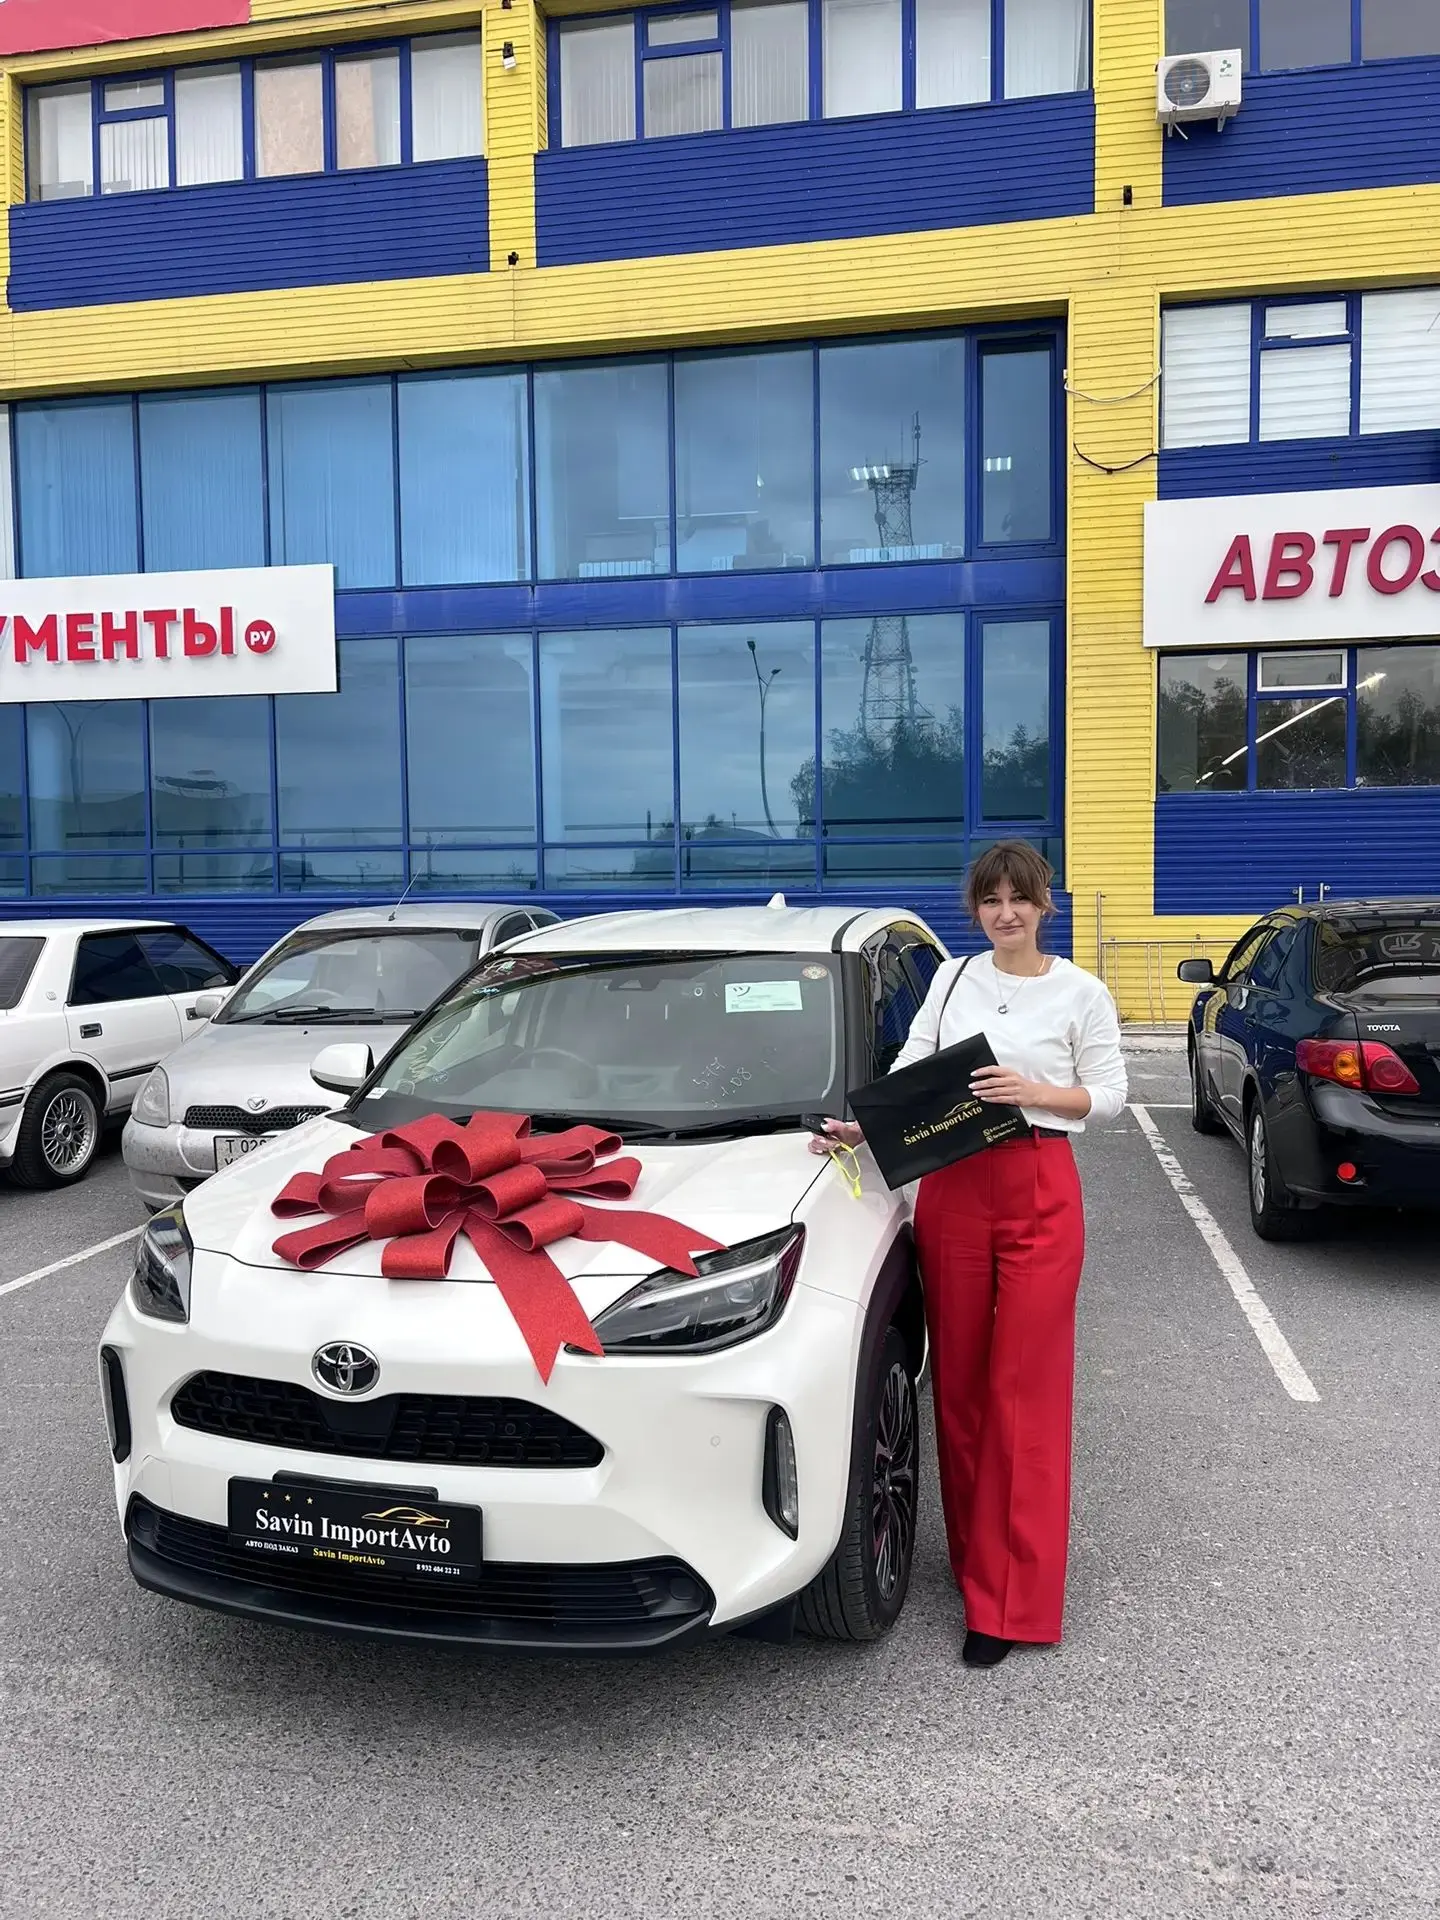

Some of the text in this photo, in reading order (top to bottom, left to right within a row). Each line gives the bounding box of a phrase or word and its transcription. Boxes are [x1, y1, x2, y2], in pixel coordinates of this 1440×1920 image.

[1367, 1024, 1401, 1032] TOYOTA
[903, 1128, 930, 1146] Savin
[930, 1105, 983, 1134] ImportAvto
[255, 1508, 451, 1554] Savin ImportAvto
[245, 1540, 299, 1554] АВТО ПОД ЗАКАЗ
[313, 1547, 386, 1566] Savin ImportAvto
